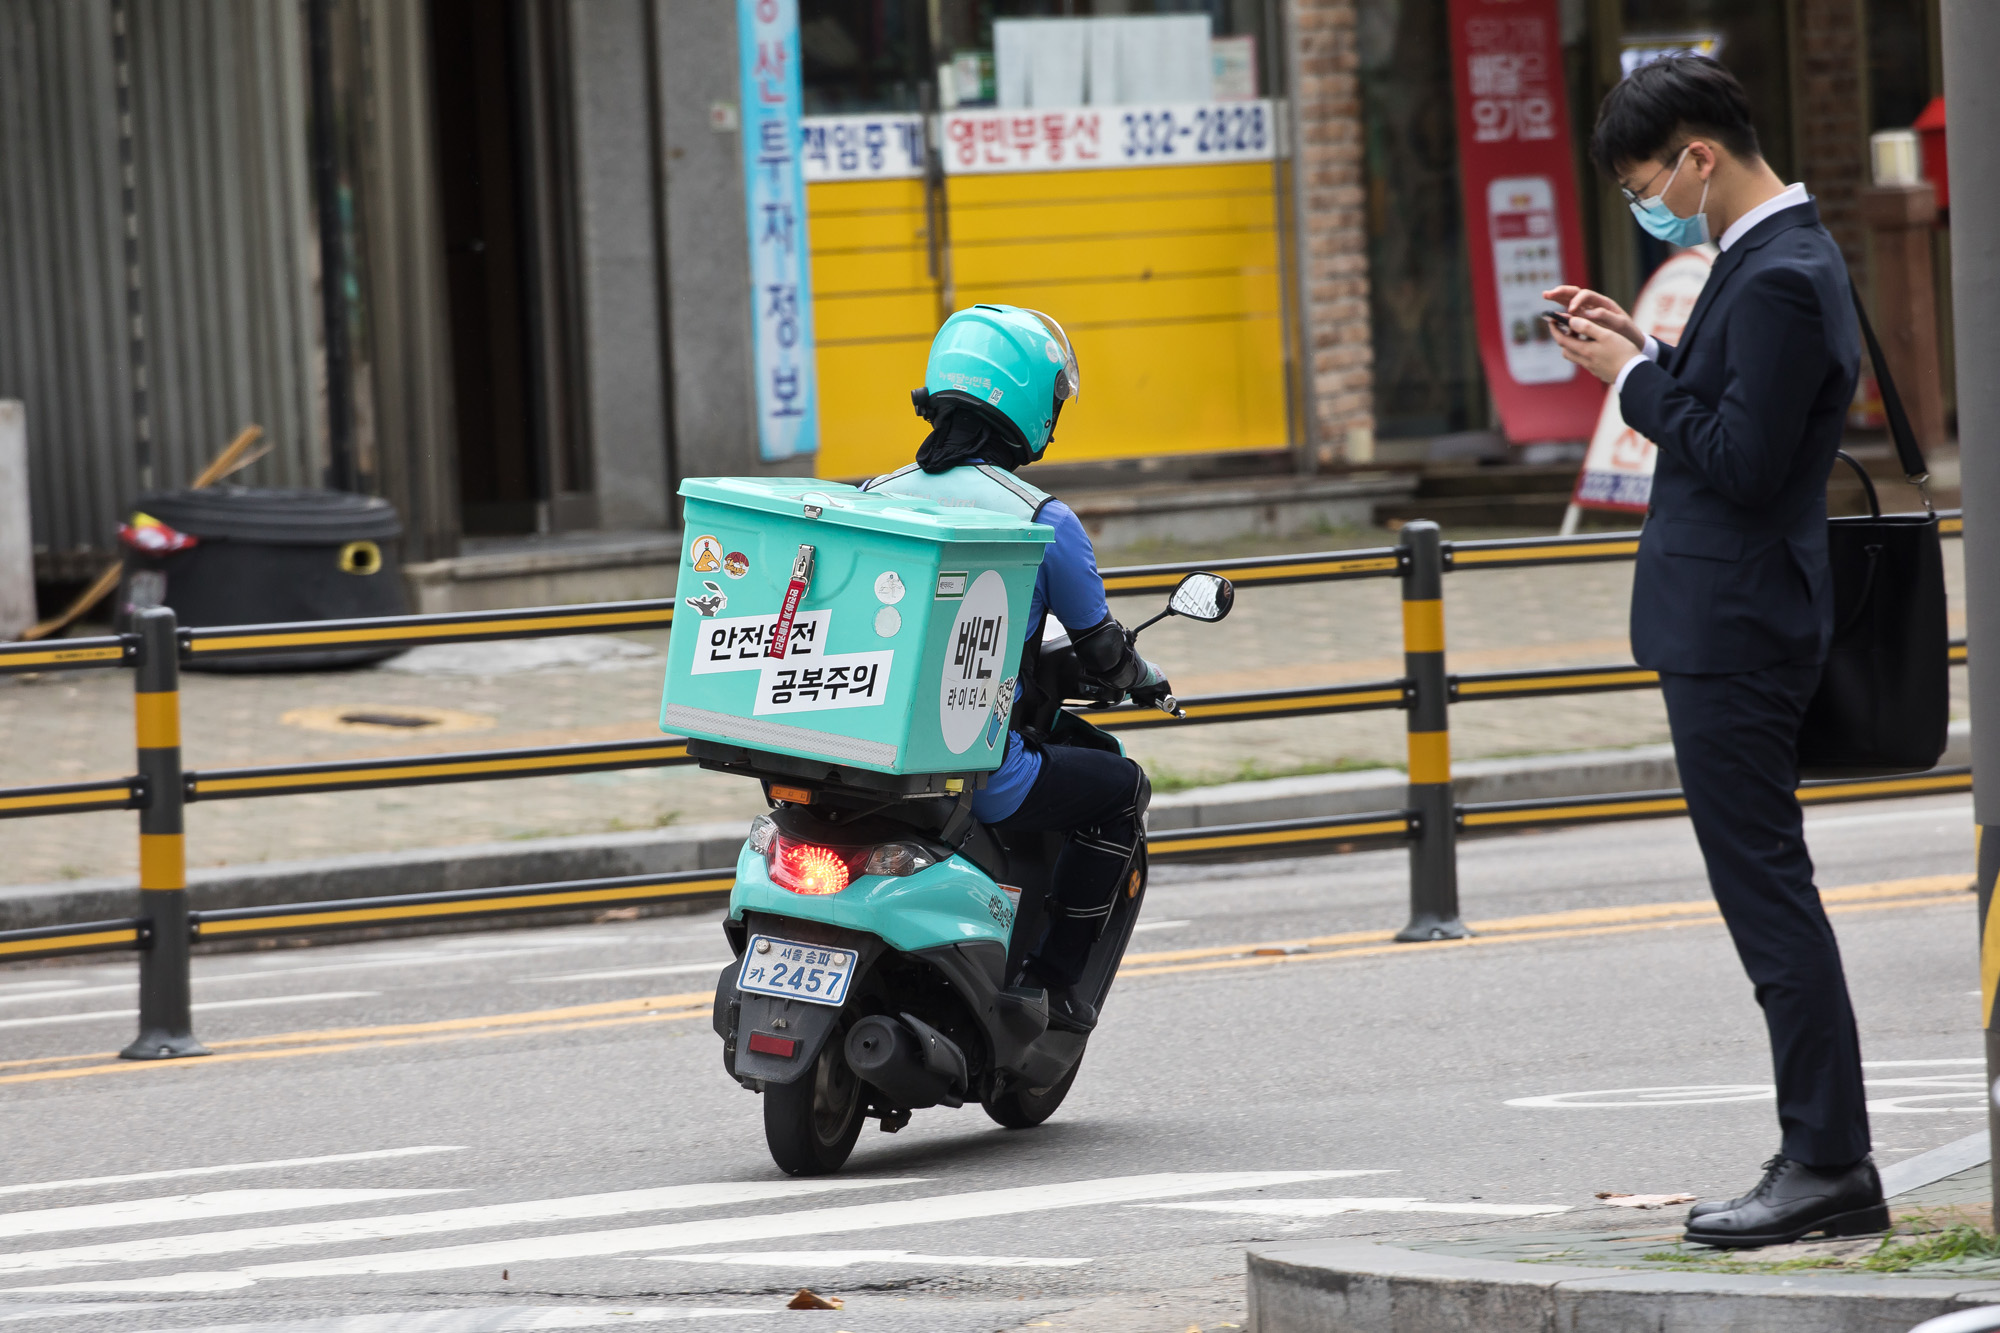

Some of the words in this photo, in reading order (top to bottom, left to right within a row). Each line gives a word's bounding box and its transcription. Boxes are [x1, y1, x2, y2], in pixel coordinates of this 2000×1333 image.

[1124, 106, 1267, 158] 332-2828
[1472, 98, 1555, 142] 요기요
[783, 589, 799, 620] 안전하게
[954, 616, 1002, 679] 배민
[771, 664, 878, 704] 공복주의
[947, 687, 986, 710] 라이더스
[781, 948, 802, 962] 서울
[805, 951, 830, 966] 송파
[749, 967, 765, 983] 카
[769, 963, 842, 995] 2457
